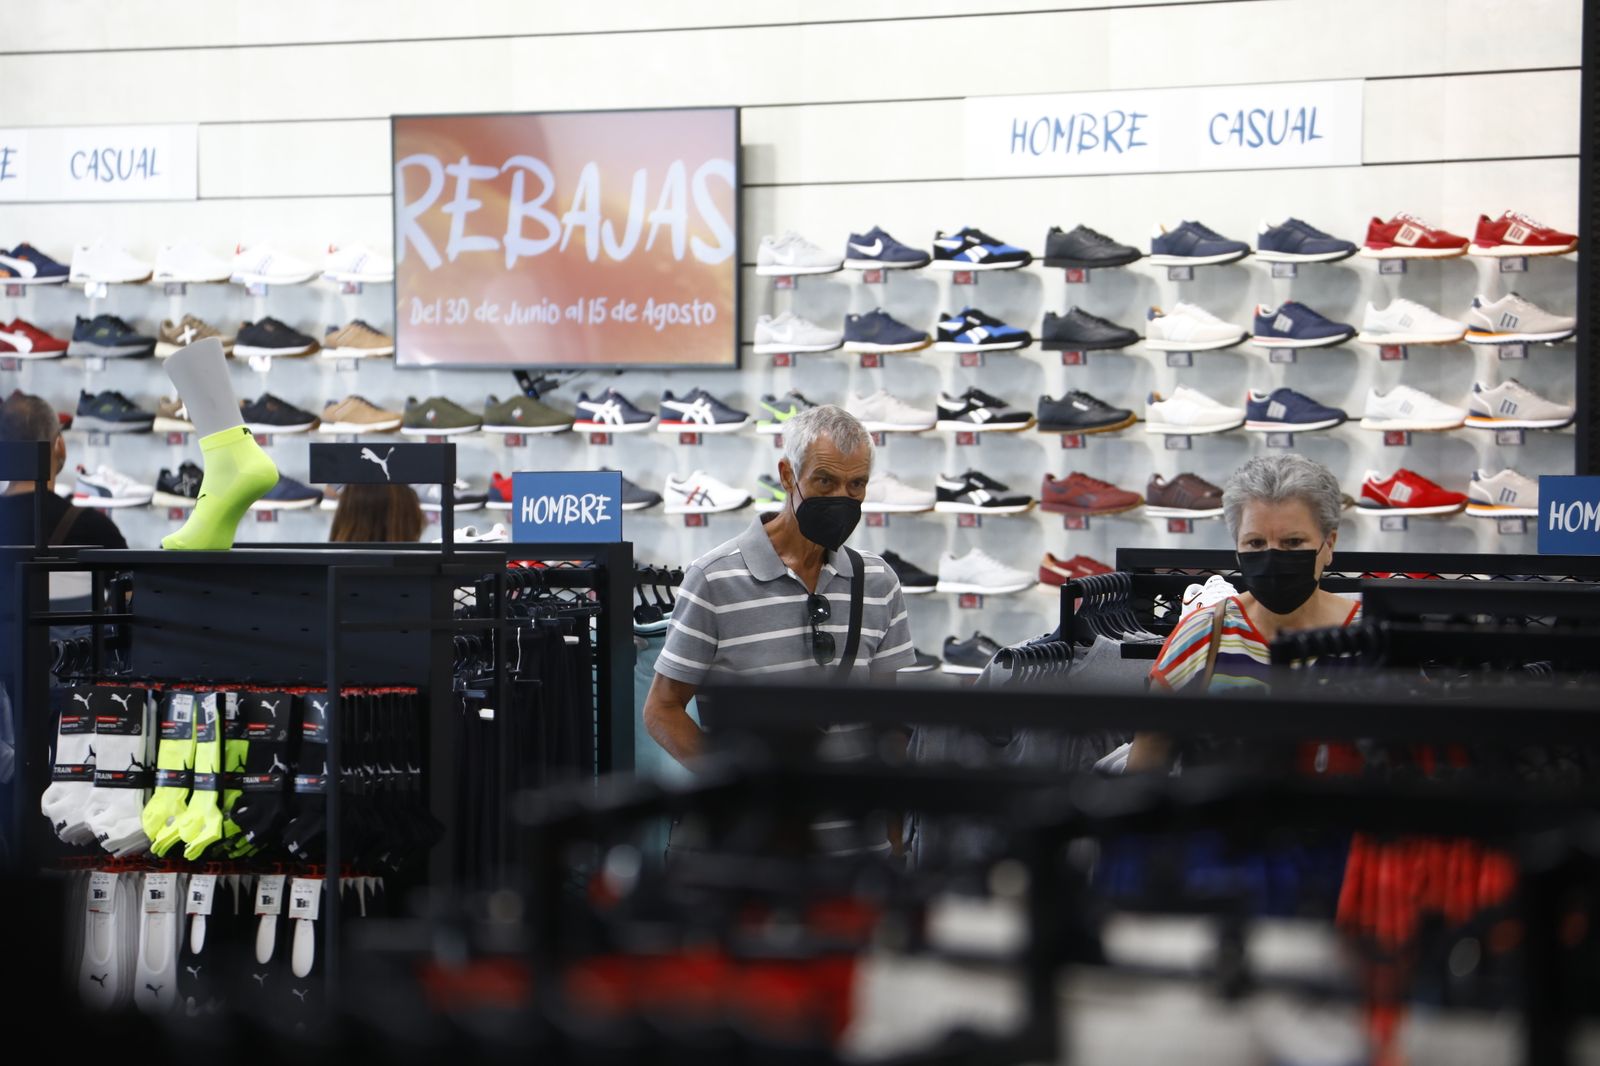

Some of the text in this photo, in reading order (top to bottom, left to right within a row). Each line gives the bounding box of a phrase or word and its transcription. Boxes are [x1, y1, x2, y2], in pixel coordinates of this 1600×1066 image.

[1010, 106, 1324, 156] HOMBRE CASUAL
[70, 146, 161, 183] CASUAL
[396, 153, 735, 270] REBAJAS
[410, 297, 717, 332] Del 30 de Junio al 15 de Agosto
[521, 493, 612, 526] HOMBRE
[1549, 500, 1600, 533] HOM
[94, 772, 113, 780] TRAIN
